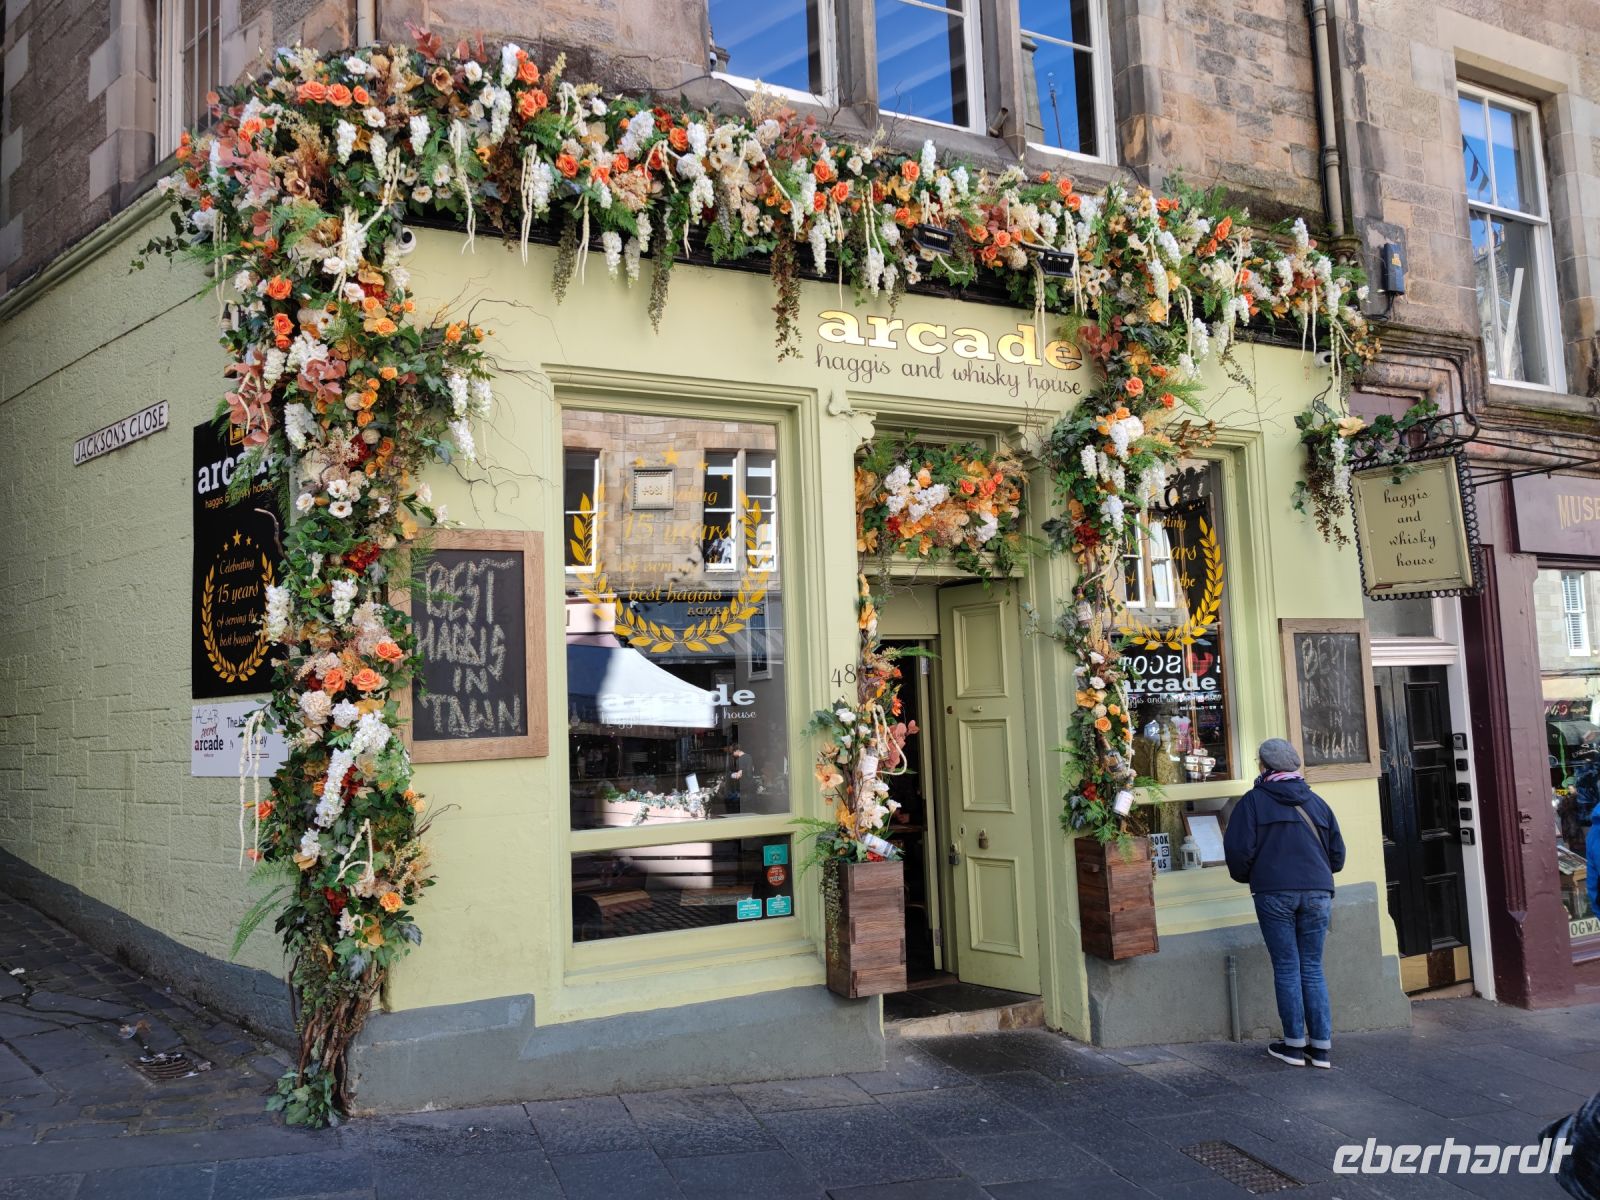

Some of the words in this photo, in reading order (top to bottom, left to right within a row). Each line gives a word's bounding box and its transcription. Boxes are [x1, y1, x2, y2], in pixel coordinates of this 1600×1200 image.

[817, 309, 1083, 371] arcade
[815, 343, 891, 383] haggis
[901, 355, 944, 380] and
[951, 361, 1021, 397] whisky
[1027, 366, 1082, 395] house
[75, 422, 126, 462] JACKSON'S
[129, 405, 165, 438] CLOSE
[252, 480, 273, 495] house
[1383, 488, 1432, 509] haggis
[1397, 509, 1422, 524] and
[1388, 528, 1437, 550] whisky
[219, 557, 256, 575] Celebrating
[1396, 552, 1436, 567] house
[217, 583, 230, 604] 15
[231, 580, 259, 605] years
[425, 557, 517, 625] BEST
[628, 582, 662, 602] best
[666, 582, 722, 604] haggis
[225, 613, 247, 627] serving
[452, 666, 489, 694] IN
[830, 663, 857, 688] 48
[722, 707, 756, 720] house
[194, 734, 224, 751] arcade
[1157, 858, 1167, 869] US
